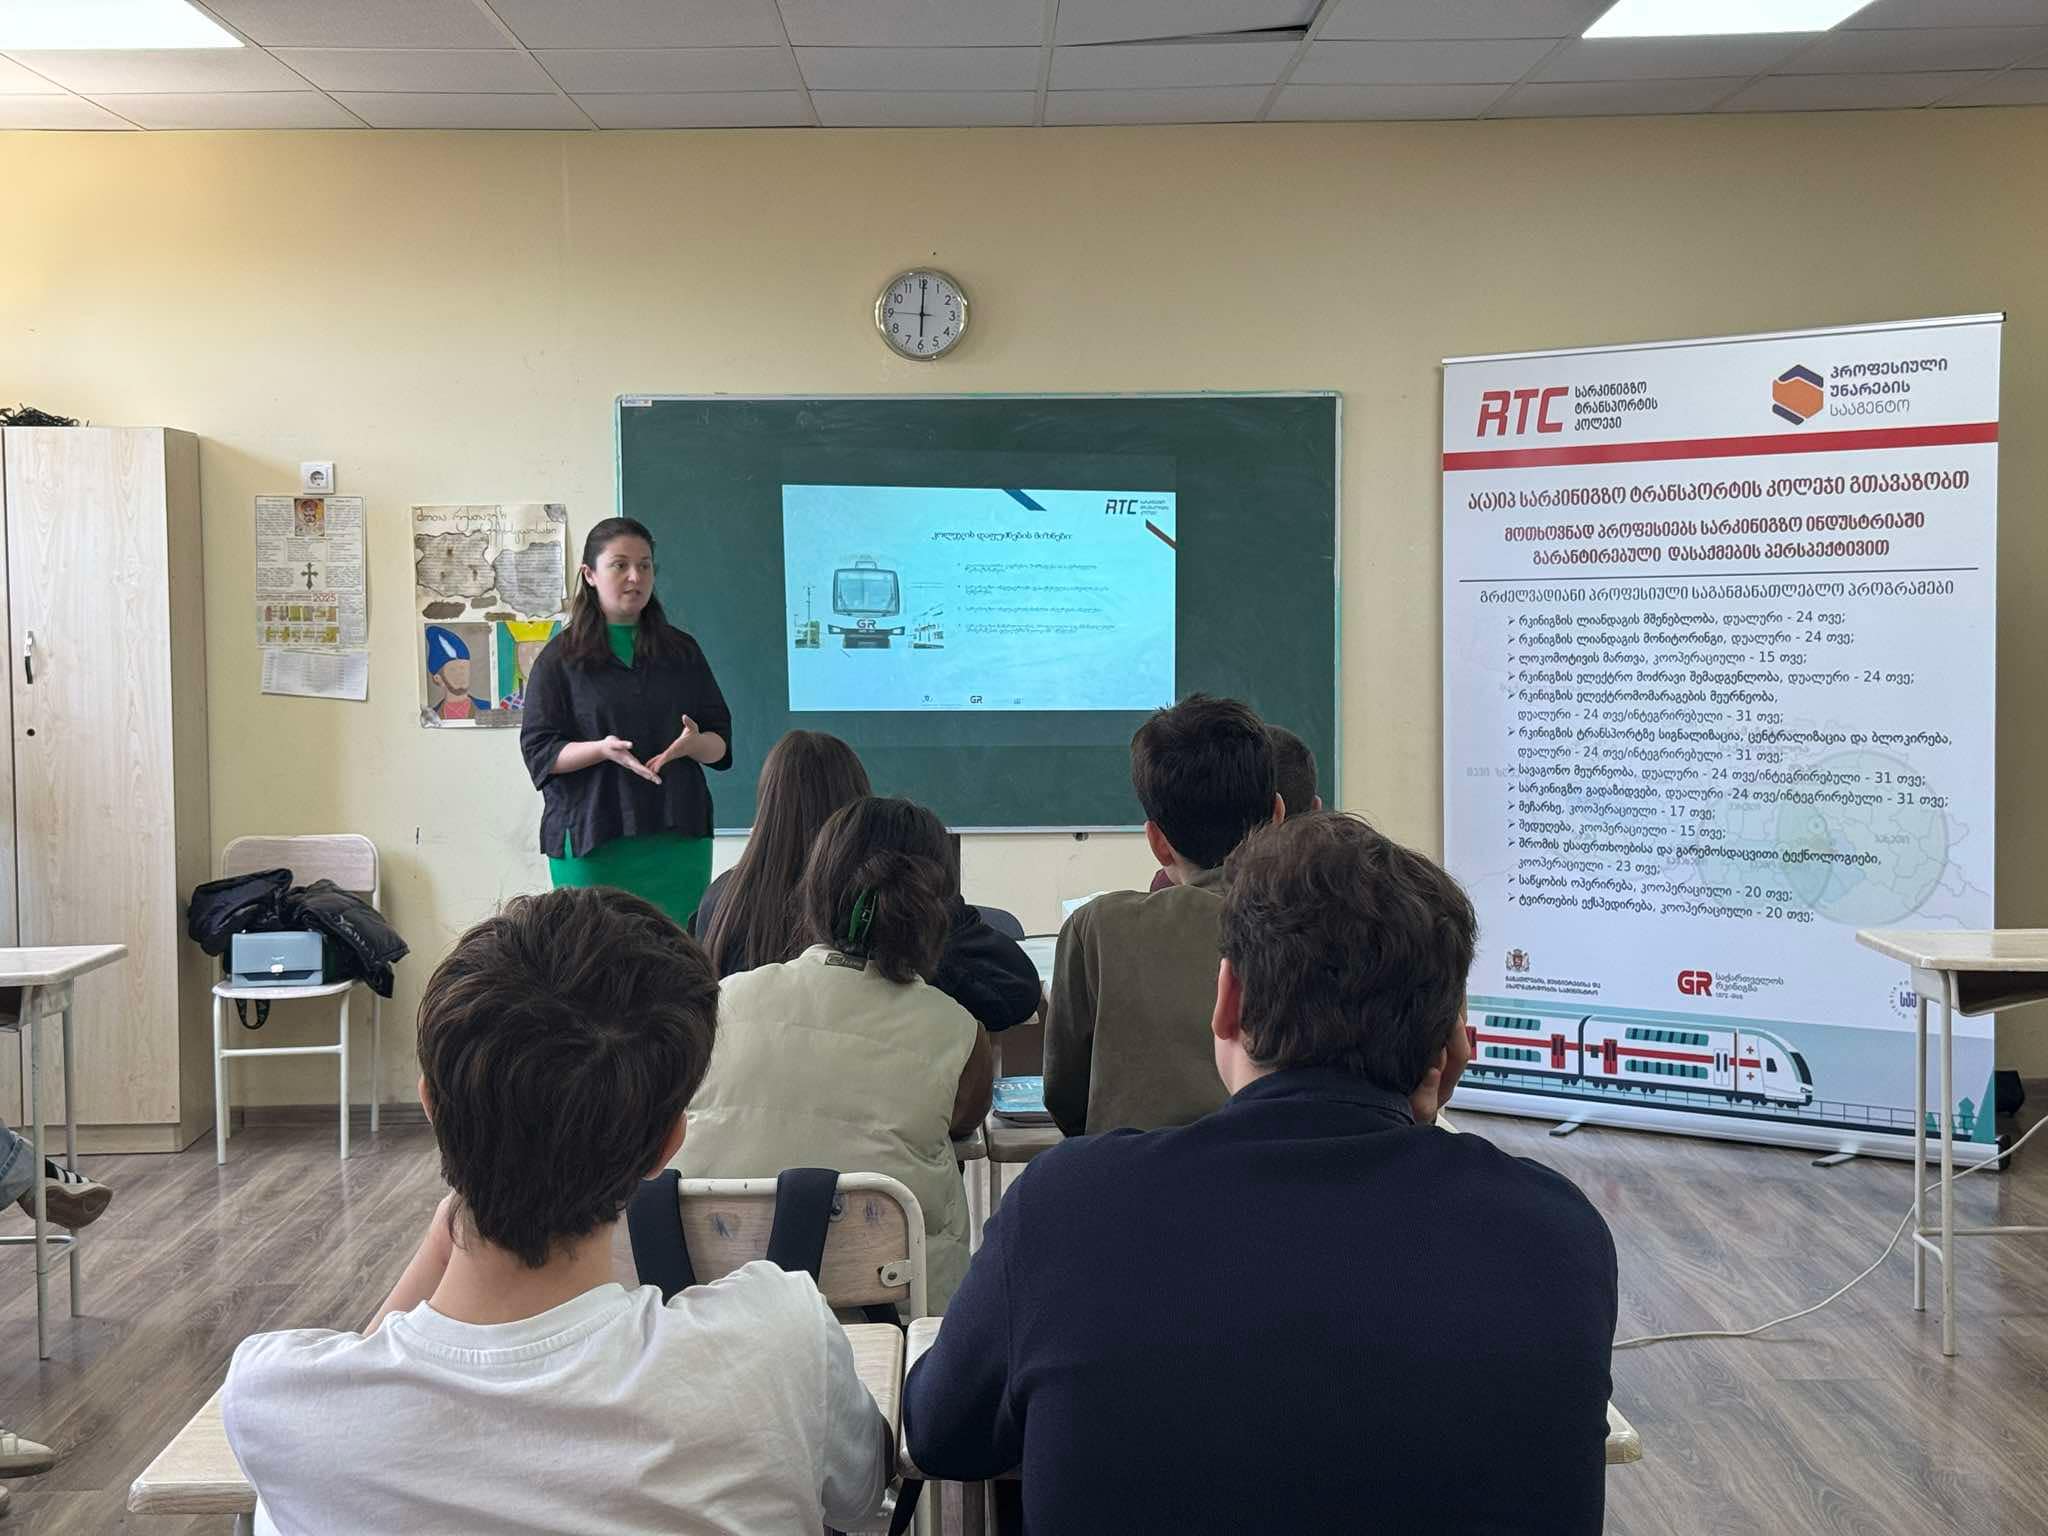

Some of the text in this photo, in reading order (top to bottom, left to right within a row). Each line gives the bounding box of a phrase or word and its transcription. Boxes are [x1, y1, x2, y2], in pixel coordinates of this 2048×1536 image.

[905, 283, 912, 294] 11
[936, 283, 940, 294] 1
[894, 293, 903, 304] 10
[944, 294, 951, 305] 2
[887, 308, 894, 318] 9
[949, 310, 956, 321] 3
[892, 322, 899, 333] 8
[943, 326, 950, 336] 4
[905, 334, 911, 344] 7
[917, 339, 924, 350] 6
[932, 336, 939, 347] 5
[1830, 358, 1948, 379] პროფესიული
[1575, 381, 1647, 398] სარკინიგზო
[1829, 379, 1911, 398] უნარების
[1476, 386, 1570, 438] RTC
[1574, 397, 1658, 415] ტრანსპორტის
[1830, 399, 1910, 417] სააგენტო
[1574, 416, 1622, 432] კოლეჯი
[1468, 470, 1969, 512] ა(ა)იპ სარკინიგზო ტრანსპორტის კოლეჯი გთავაზობთ
[1105, 499, 1138, 515] RTC
[1504, 511, 1925, 543] მოთხოვნად პროფესიებს სარკინიგზო ინდუსტრიაში
[1533, 539, 1890, 565] გარანტირებული დასაქმების პერსპექტივით
[1480, 580, 1954, 604] გრძელვადიანი პროფესიული საგანმანათლებლო პროგრამები
[857, 619, 877, 629] GR
[1518, 613, 1573, 629] რკინიგზის
[1576, 612, 1640, 629] ლიანდაგის
[1722, 610, 1783, 626] დუალური
[1796, 610, 1814, 623] 24
[1518, 632, 1575, 648] რკინიგზის
[1576, 631, 1642, 647] ლიანდაგის
[1731, 630, 1792, 647] დუალური
[1805, 630, 1822, 643] 24
[1518, 651, 1600, 666] ლოკომოტივის
[1652, 650, 1746, 666] კოოპერაციული
[1759, 650, 1775, 664] 15
[1518, 669, 1574, 685] რკინიგზის
[1575, 670, 1633, 686] ელექტრო
[1636, 670, 1686, 685] მოძრავი
[1787, 670, 1850, 685] დუალური
[1864, 670, 1882, 683] 24
[970, 695, 983, 704] GR
[1518, 688, 1574, 704] რკინიგზის
[1575, 688, 1707, 706] ელექტრომომარაგების
[1517, 707, 1572, 723] დუალური
[1583, 708, 1599, 720] 24
[1736, 709, 1752, 722] 31
[1518, 725, 1574, 743] რკინიგზის
[1575, 726, 1656, 743] ტრანსპორტზე
[1748, 727, 1847, 746] ცენტრალიზაცია
[1850, 734, 1868, 746] და
[1517, 745, 1573, 761] დუალური
[1583, 745, 1599, 759] 24
[1736, 748, 1752, 761] 31
[1518, 762, 1572, 779] სავაგონო
[1641, 766, 1699, 782] დუალური
[1711, 767, 1729, 781] 24
[1874, 771, 1892, 784] 31
[1518, 781, 1583, 797] სარკინიგზო
[1665, 785, 1724, 801] დუალური
[1897, 792, 1915, 805] 31
[1567, 802, 1658, 819] კოოპერაციული
[1670, 805, 1686, 817] 17
[1576, 821, 1668, 838] კოოპერაციული
[1680, 824, 1696, 837] 15
[1518, 837, 1561, 852] შრომის
[1562, 839, 1654, 856] უსაფრთხოებისა
[1656, 843, 1674, 858] და
[1675, 843, 1779, 861] გარემოსდაცვითი
[1518, 856, 1604, 873] კოოპერაციული
[1615, 859, 1634, 872] 23
[1518, 873, 1569, 890] საწყობის
[1640, 881, 1732, 896] კოოპერაციული
[1743, 885, 1762, 898] 20
[1518, 893, 1579, 909] ტვირთების
[1660, 901, 1753, 919] კოოპერაციული
[1765, 906, 1783, 919] 20
[1677, 970, 1713, 997] GR
